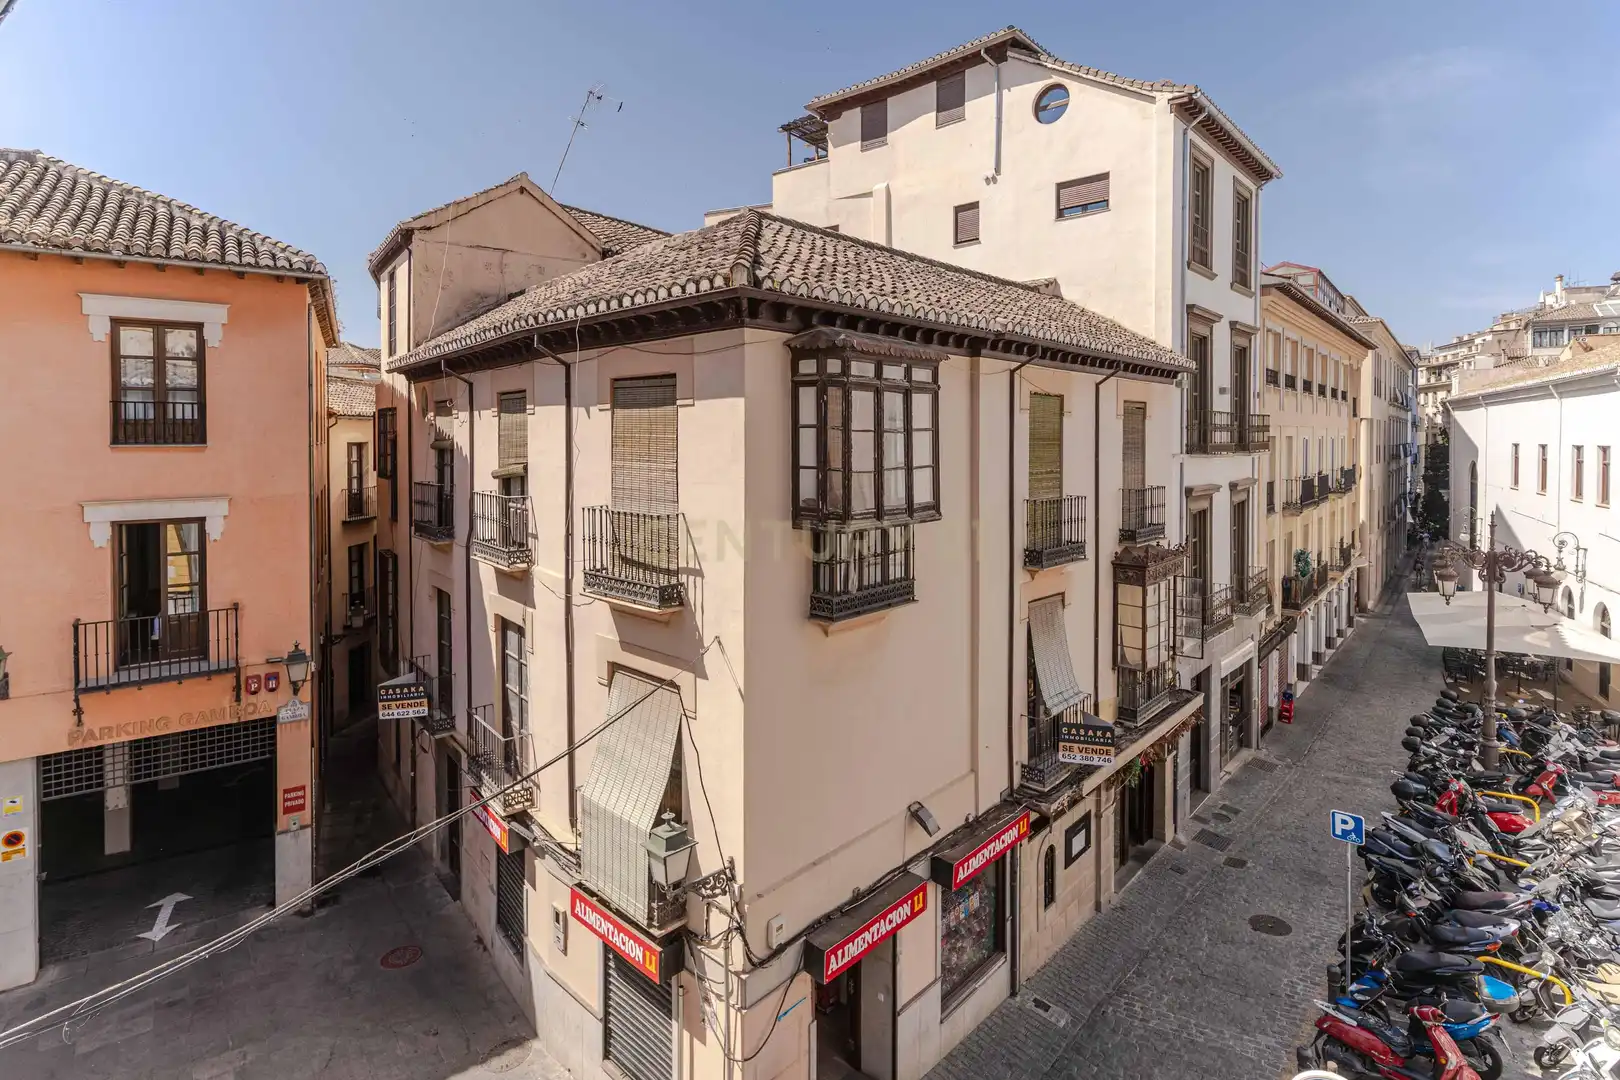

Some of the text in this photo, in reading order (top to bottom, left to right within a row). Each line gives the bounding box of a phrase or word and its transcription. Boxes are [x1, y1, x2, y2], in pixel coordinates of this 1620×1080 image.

[380, 686, 425, 695] CASAKA
[380, 692, 425, 700] INMOBILIARIA
[381, 701, 425, 711] SE VENDE
[67, 700, 272, 746] PARKING GAMBOA
[1062, 727, 1112, 738] CASAKA
[1061, 734, 1113, 743] INMOBILIARIA
[1062, 744, 1112, 756] SE VENDE
[1062, 753, 1077, 761] 652
[284, 789, 305, 799] PARKING
[284, 798, 305, 808] PRIVADO
[1334, 812, 1356, 836] P
[955, 817, 1028, 883] ALIMENTACION LI
[574, 898, 657, 974] ALIMENTACION LI
[827, 899, 912, 975] ALIMENTACION
[913, 891, 924, 913] LI
